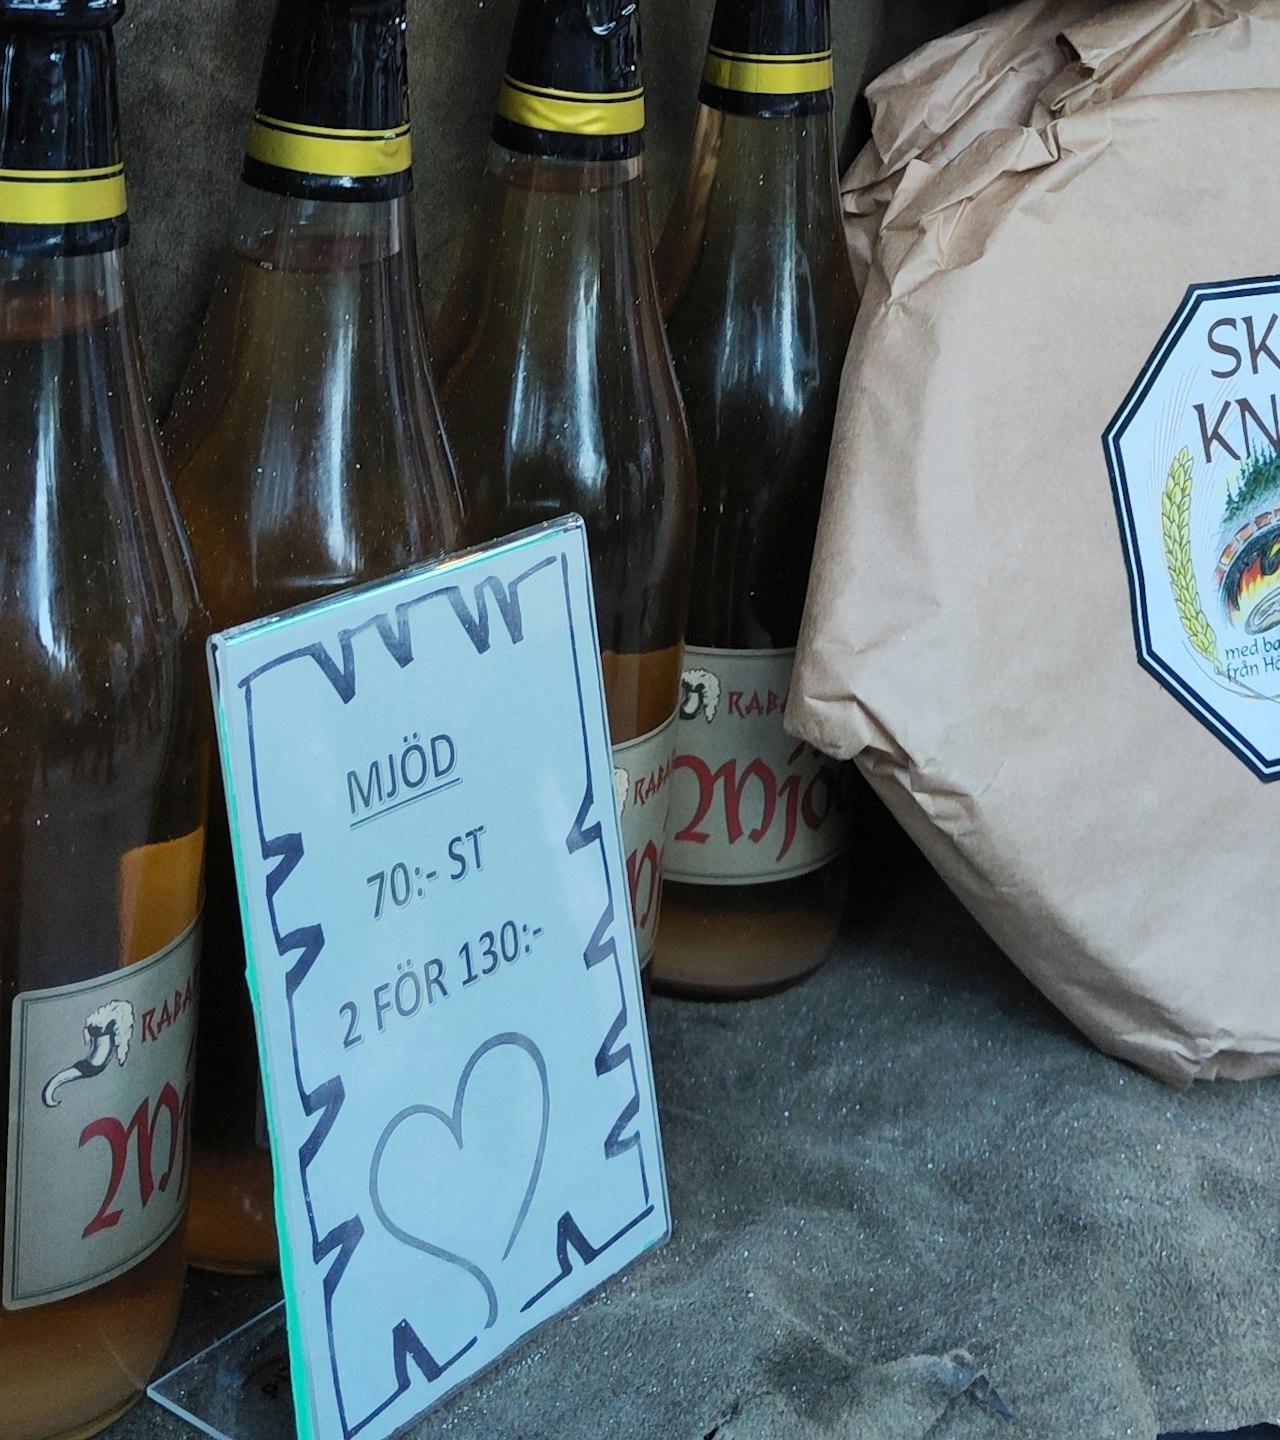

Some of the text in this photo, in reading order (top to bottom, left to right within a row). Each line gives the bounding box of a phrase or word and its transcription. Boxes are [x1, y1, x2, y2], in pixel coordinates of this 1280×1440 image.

[1225, 639, 1259, 661] med
[1226, 659, 1259, 683] från
[347, 732, 457, 815] MJÖD
[366, 825, 486, 920] 70:- ST
[339, 920, 543, 1049] 2 FÖR 130:-
